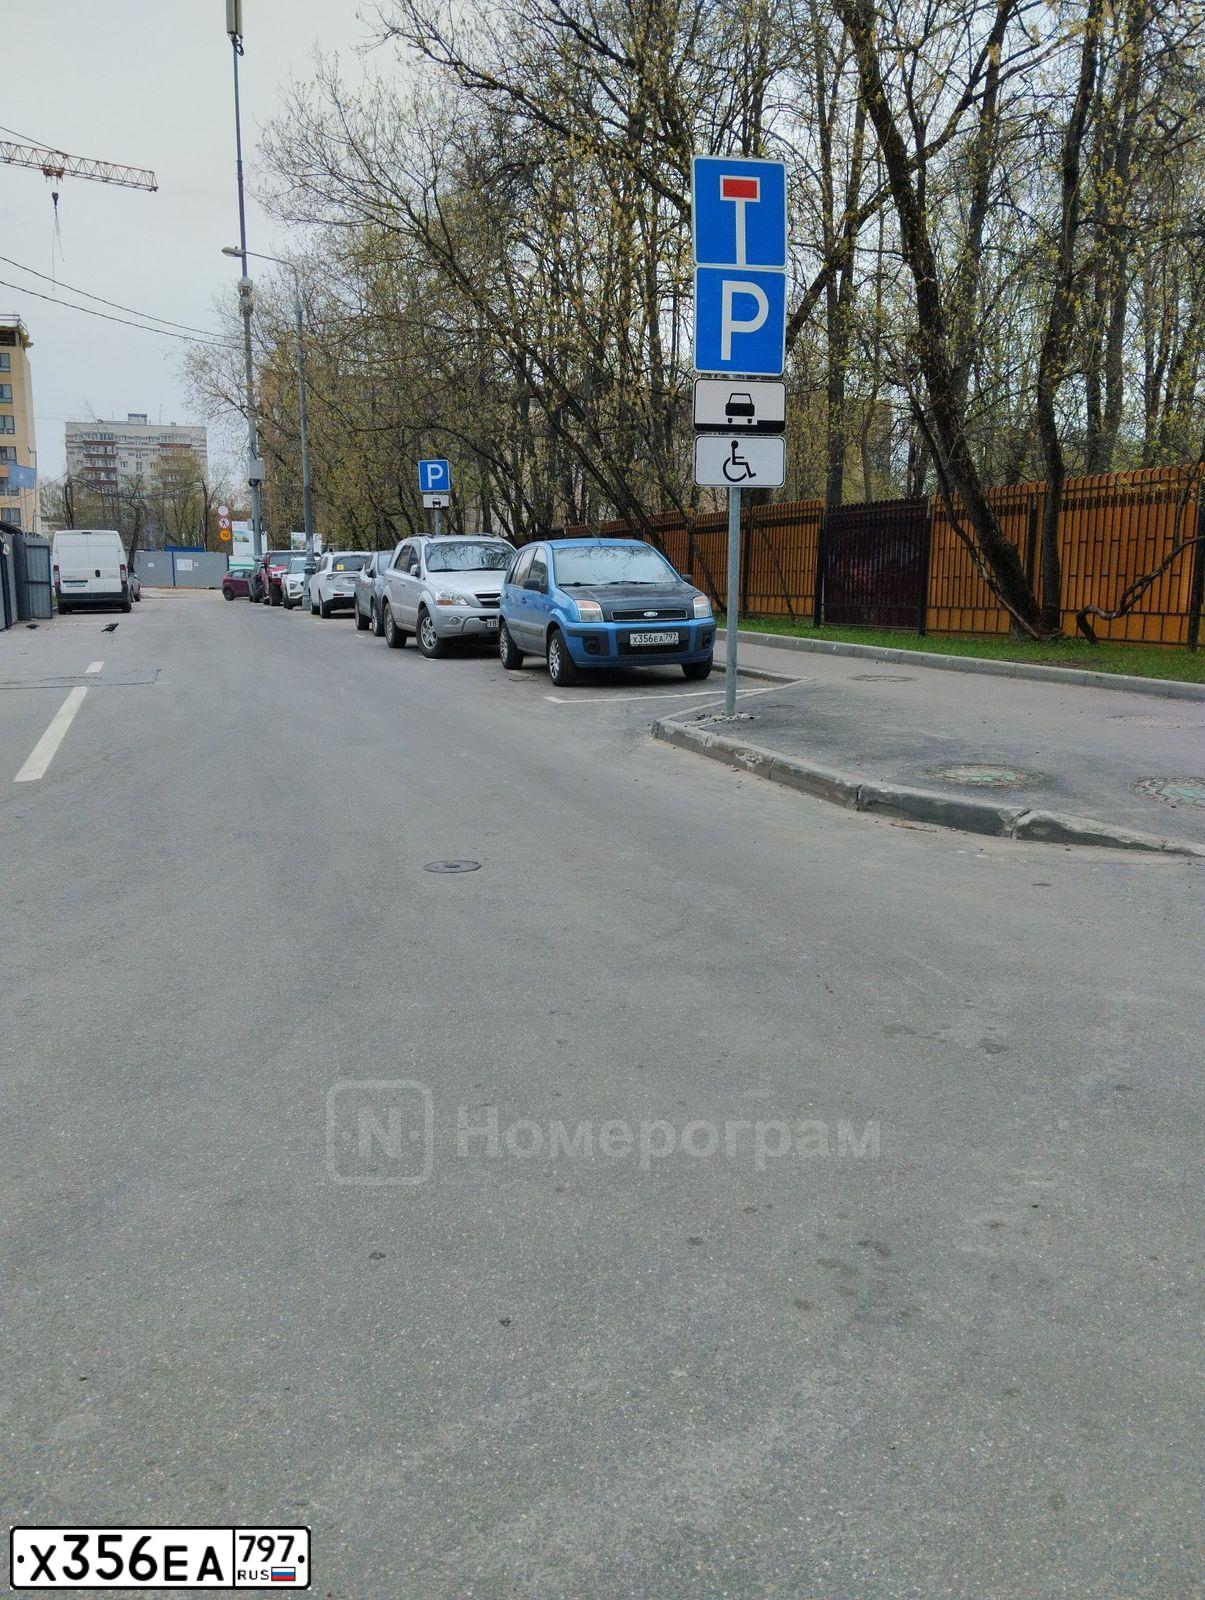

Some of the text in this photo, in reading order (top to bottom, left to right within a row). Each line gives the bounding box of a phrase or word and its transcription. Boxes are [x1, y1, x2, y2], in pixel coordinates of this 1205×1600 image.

[721, 279, 769, 361] P
[427, 463, 444, 488] P
[665, 632, 677, 640] 797
